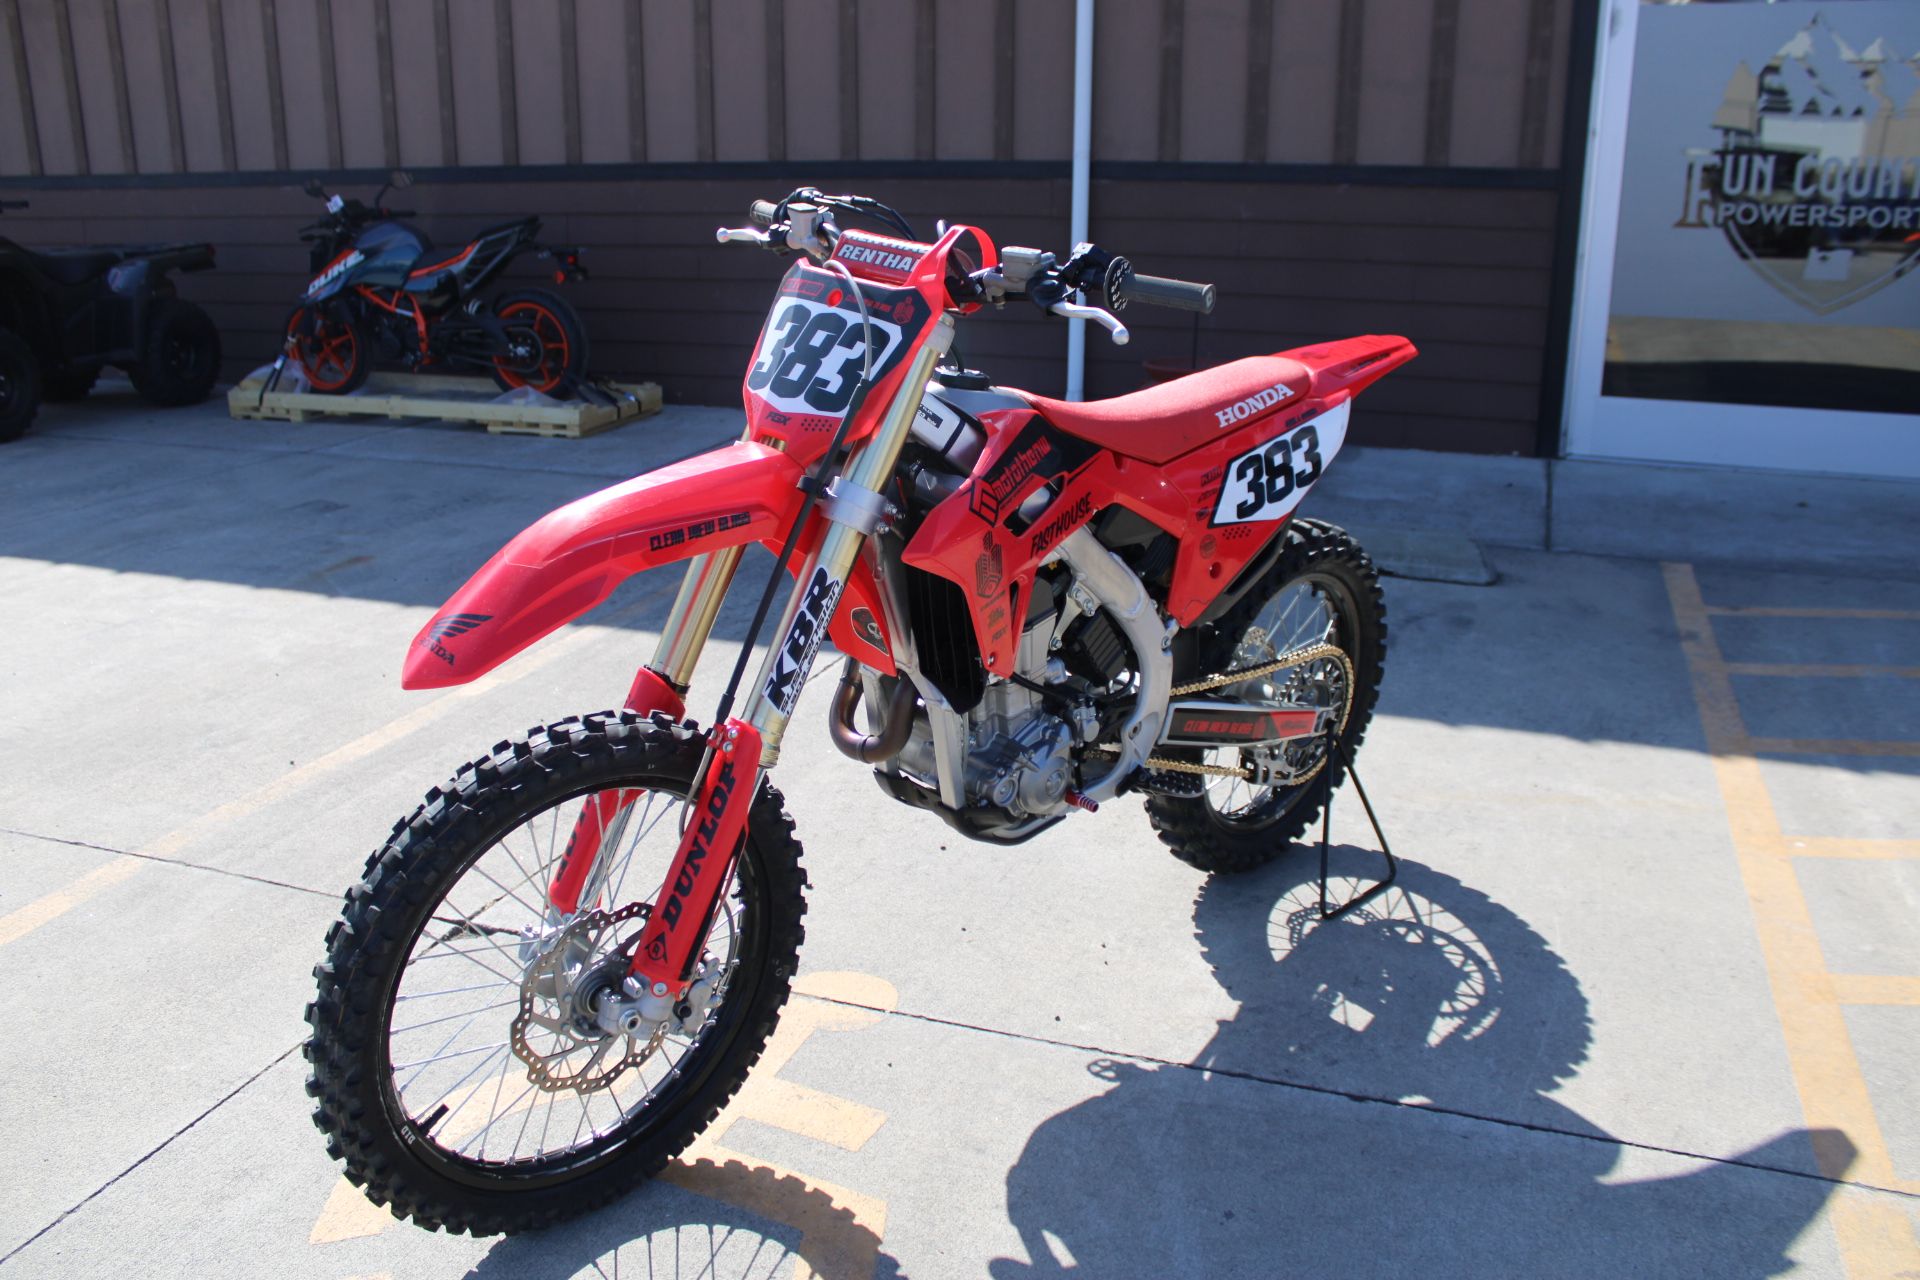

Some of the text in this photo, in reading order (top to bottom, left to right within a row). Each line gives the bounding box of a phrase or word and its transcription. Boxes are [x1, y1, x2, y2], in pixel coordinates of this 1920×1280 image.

[308, 249, 365, 295] DUKE
[747, 303, 890, 413] 383
[1215, 383, 1295, 428] HONDA
[1236, 425, 1322, 519] 383
[1030, 491, 1093, 559] FASTHOUSE
[764, 566, 840, 711] KBR
[661, 761, 735, 933] DUNLOP
